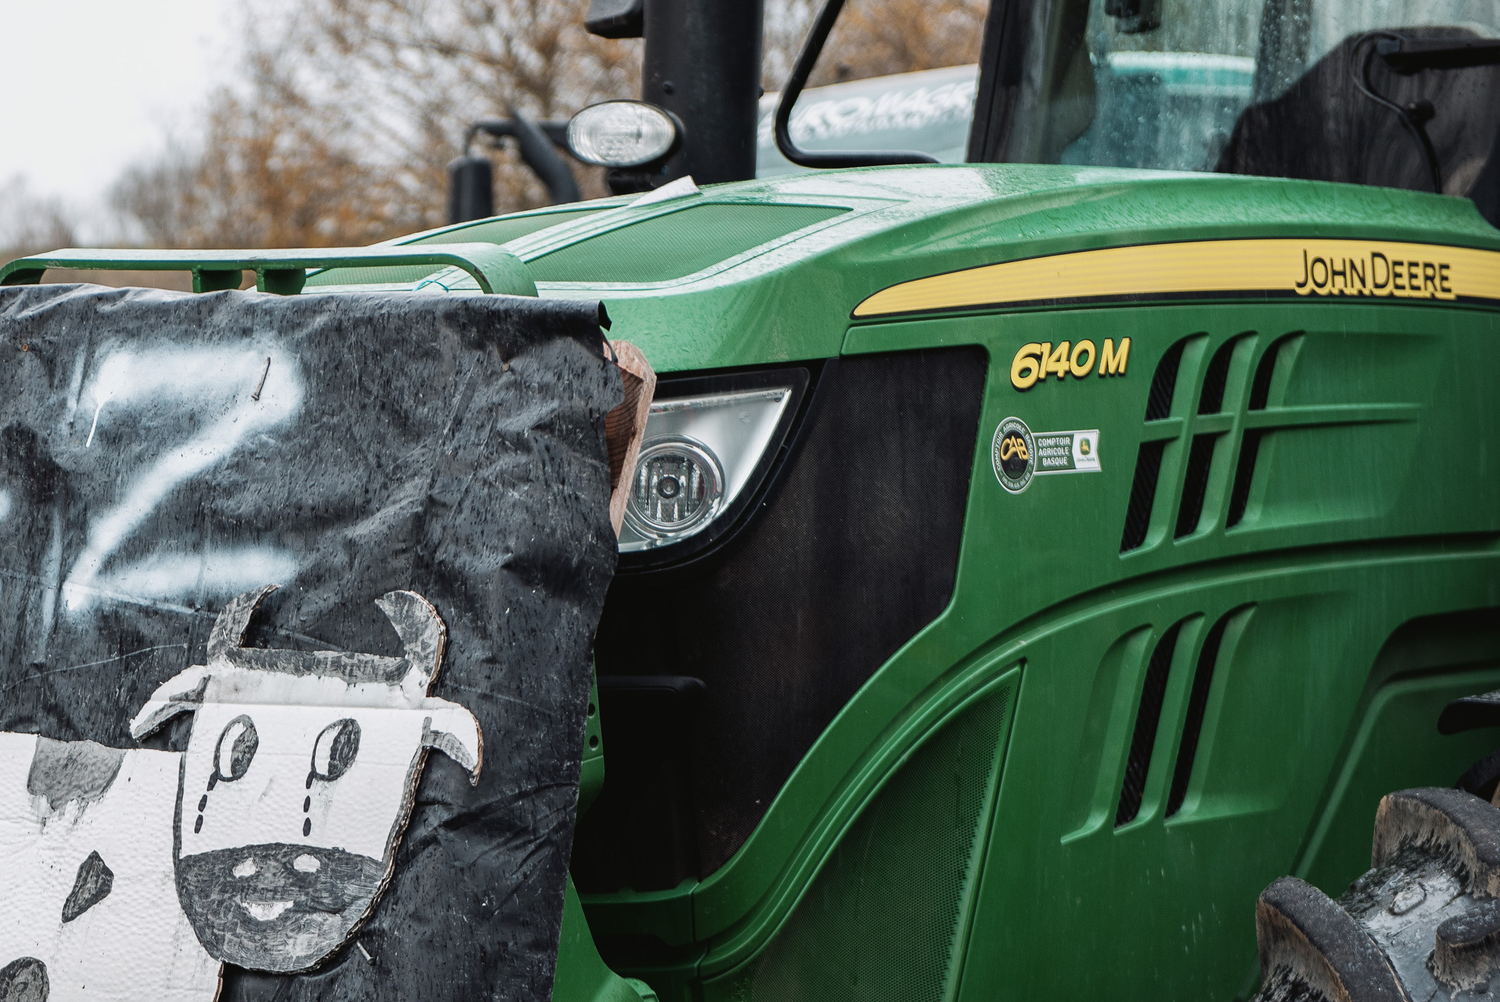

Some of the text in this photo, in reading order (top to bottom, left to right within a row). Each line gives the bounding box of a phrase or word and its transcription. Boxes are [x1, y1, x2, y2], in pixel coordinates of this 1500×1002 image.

[1294, 248, 1454, 296] JOHN DEERE
[1010, 336, 1131, 392] 6140 M
[1000, 435, 1029, 461] CAB
[1037, 437, 1071, 447] COMPTOIR
[1038, 446, 1070, 456] AGRICOLE
[1042, 456, 1069, 466] BASQUE
